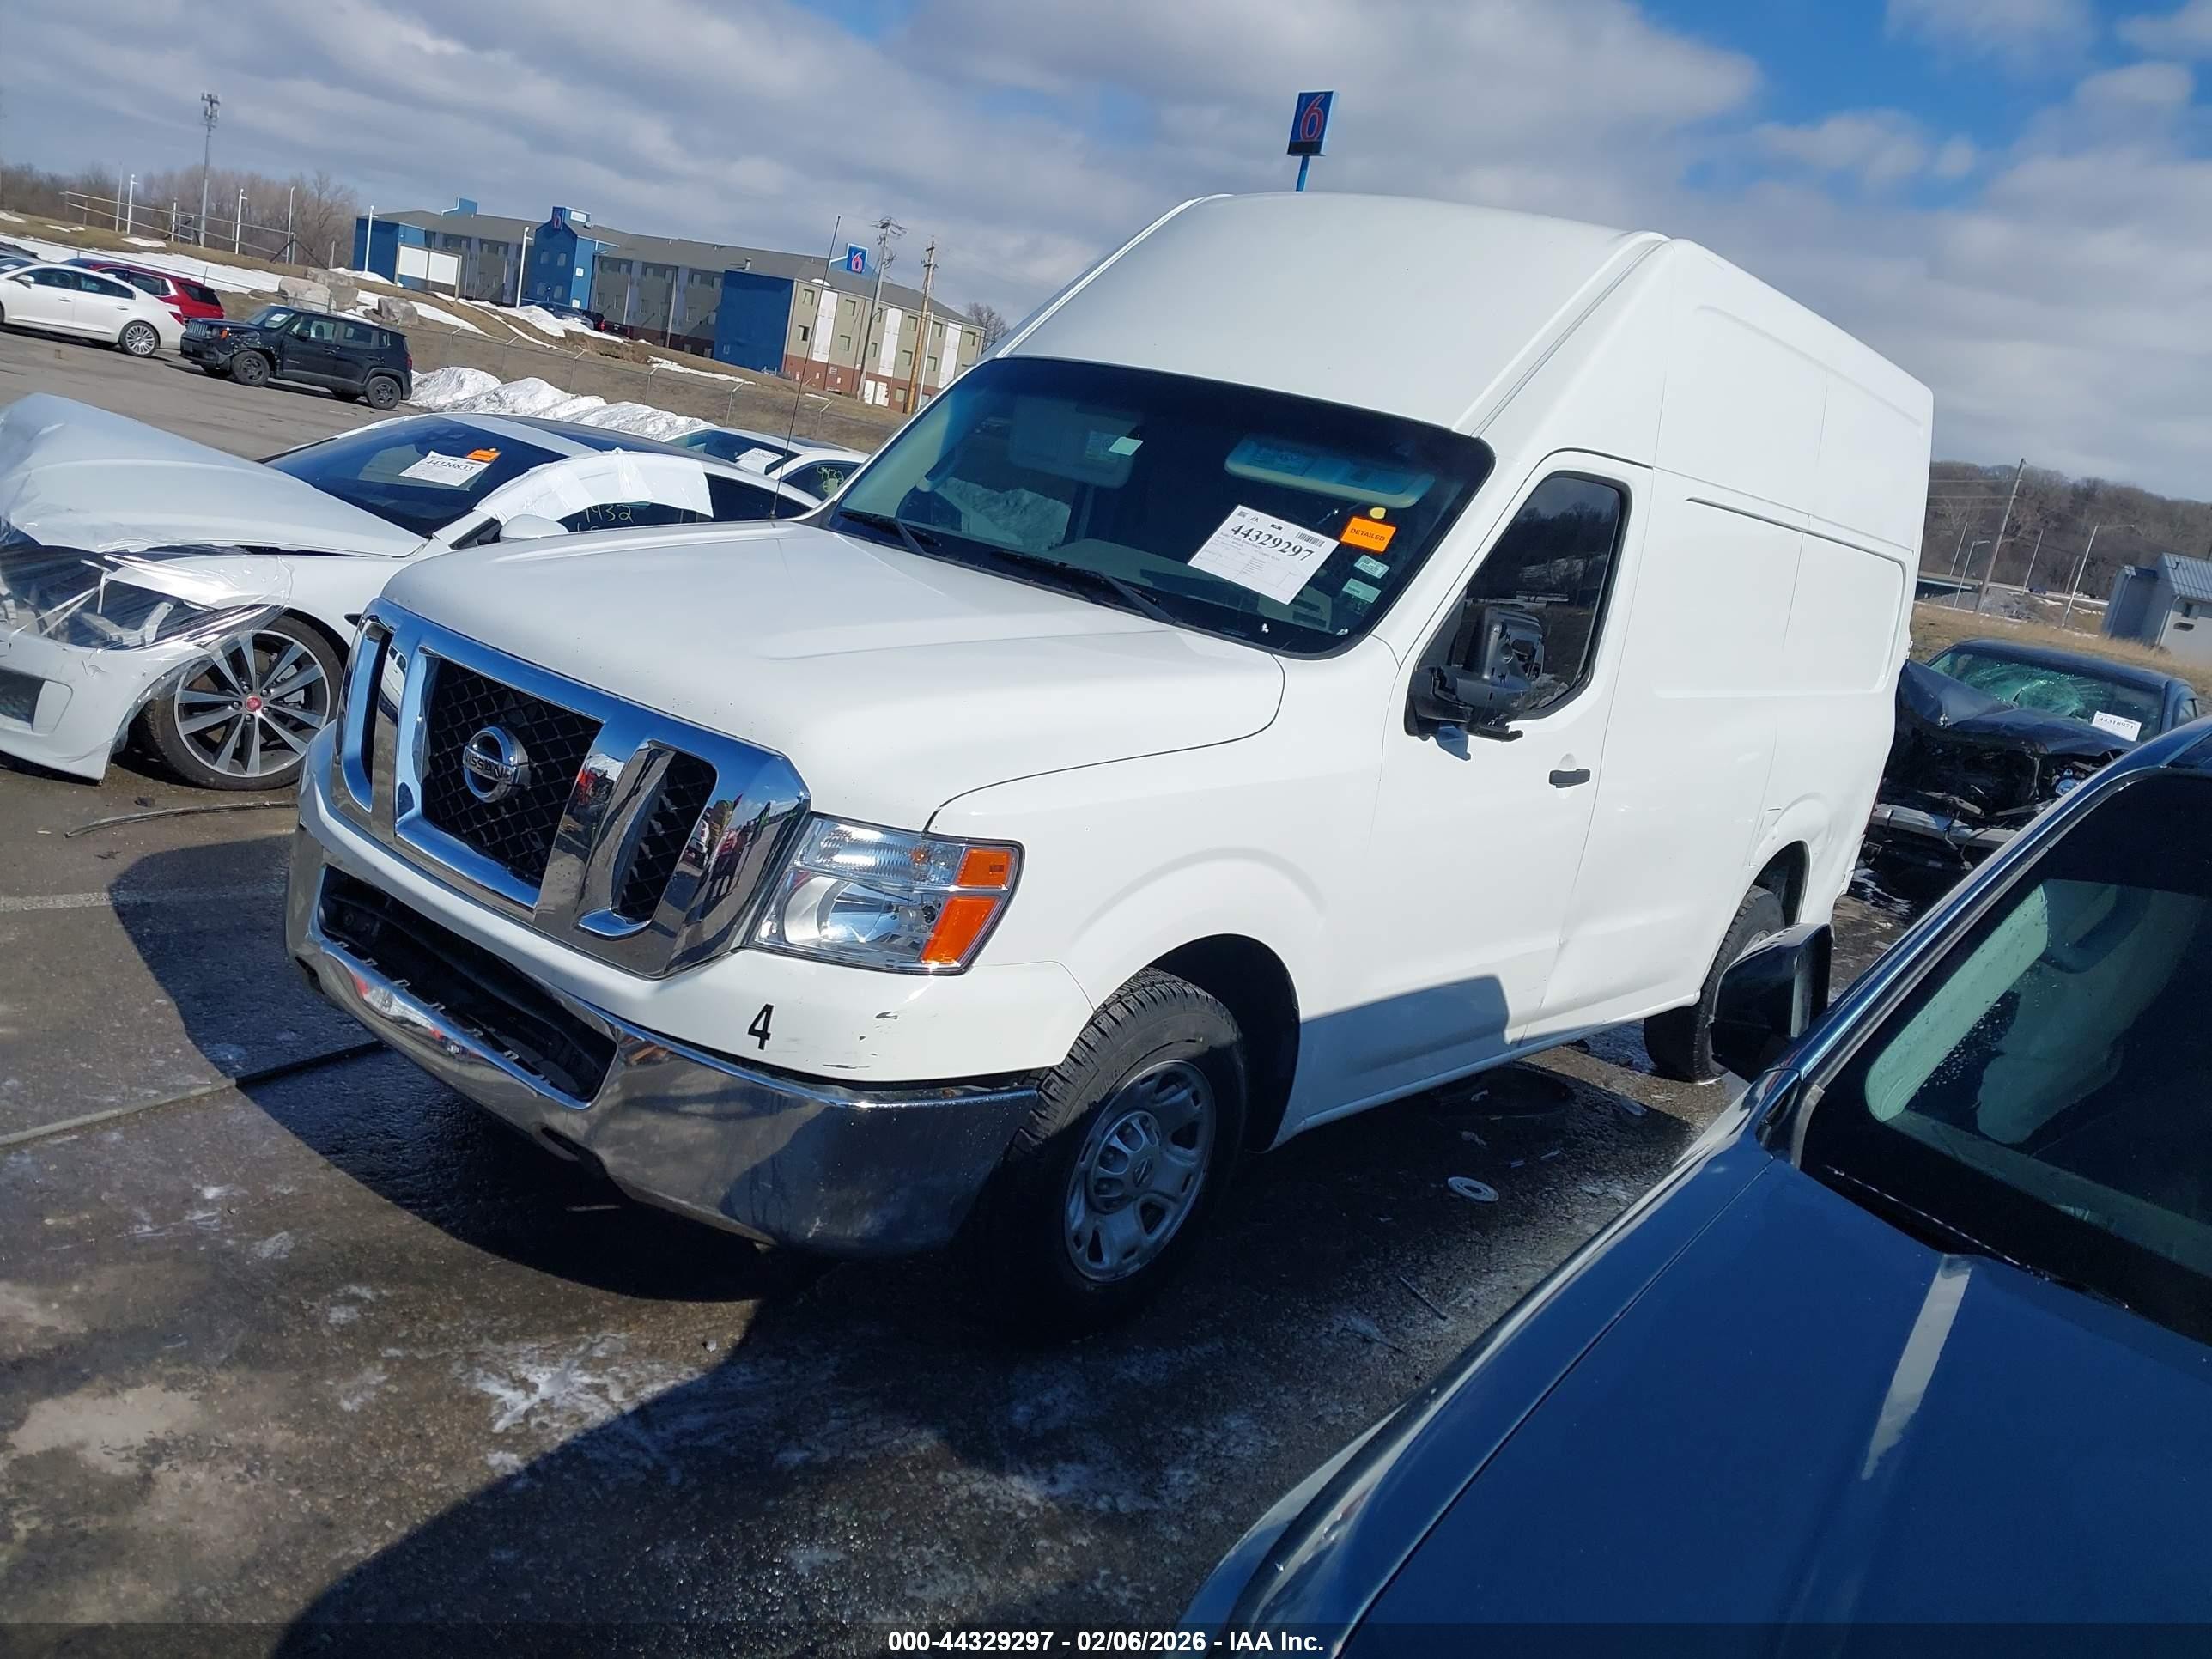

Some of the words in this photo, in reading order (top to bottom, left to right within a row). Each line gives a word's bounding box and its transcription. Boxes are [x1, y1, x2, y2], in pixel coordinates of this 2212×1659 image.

[1300, 93, 1325, 142] 6
[852, 252, 863, 272] 6
[1231, 523, 1315, 562] 44329297
[1350, 527, 1386, 542] DETAILED
[748, 1003, 775, 1051] 4
